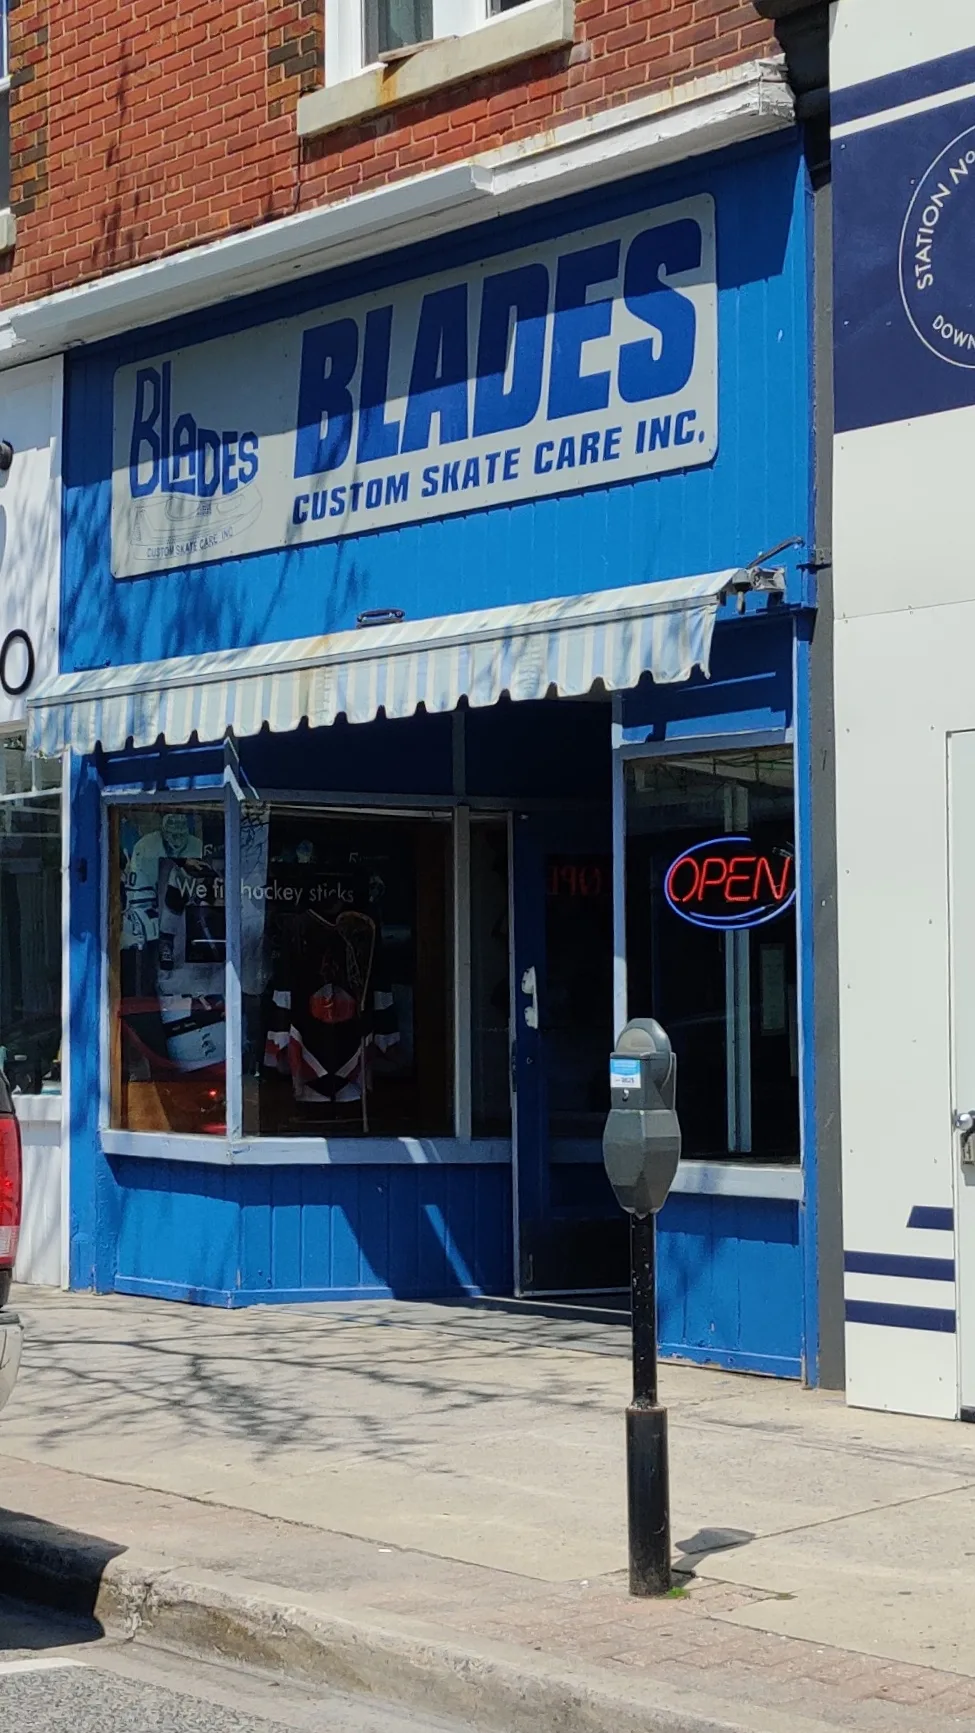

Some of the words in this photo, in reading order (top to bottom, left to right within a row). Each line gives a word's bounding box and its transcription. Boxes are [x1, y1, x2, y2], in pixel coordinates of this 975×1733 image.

[915, 183, 951, 290] STATION
[293, 218, 702, 478] BLADES
[129, 361, 259, 498] BLADES
[292, 472, 410, 525] CUSTOM
[422, 447, 520, 498] SKATE
[533, 428, 621, 475] CARE
[635, 410, 705, 452] INC.
[147, 545, 174, 557] CUSTOM
[175, 540, 197, 554] SKATE
[199, 534, 218, 549] CARE
[178, 876, 208, 899] We
[213, 878, 227, 900] fi
[241, 878, 303, 906] hockey
[308, 882, 355, 903] sticks
[668, 856, 791, 902] OPEN
